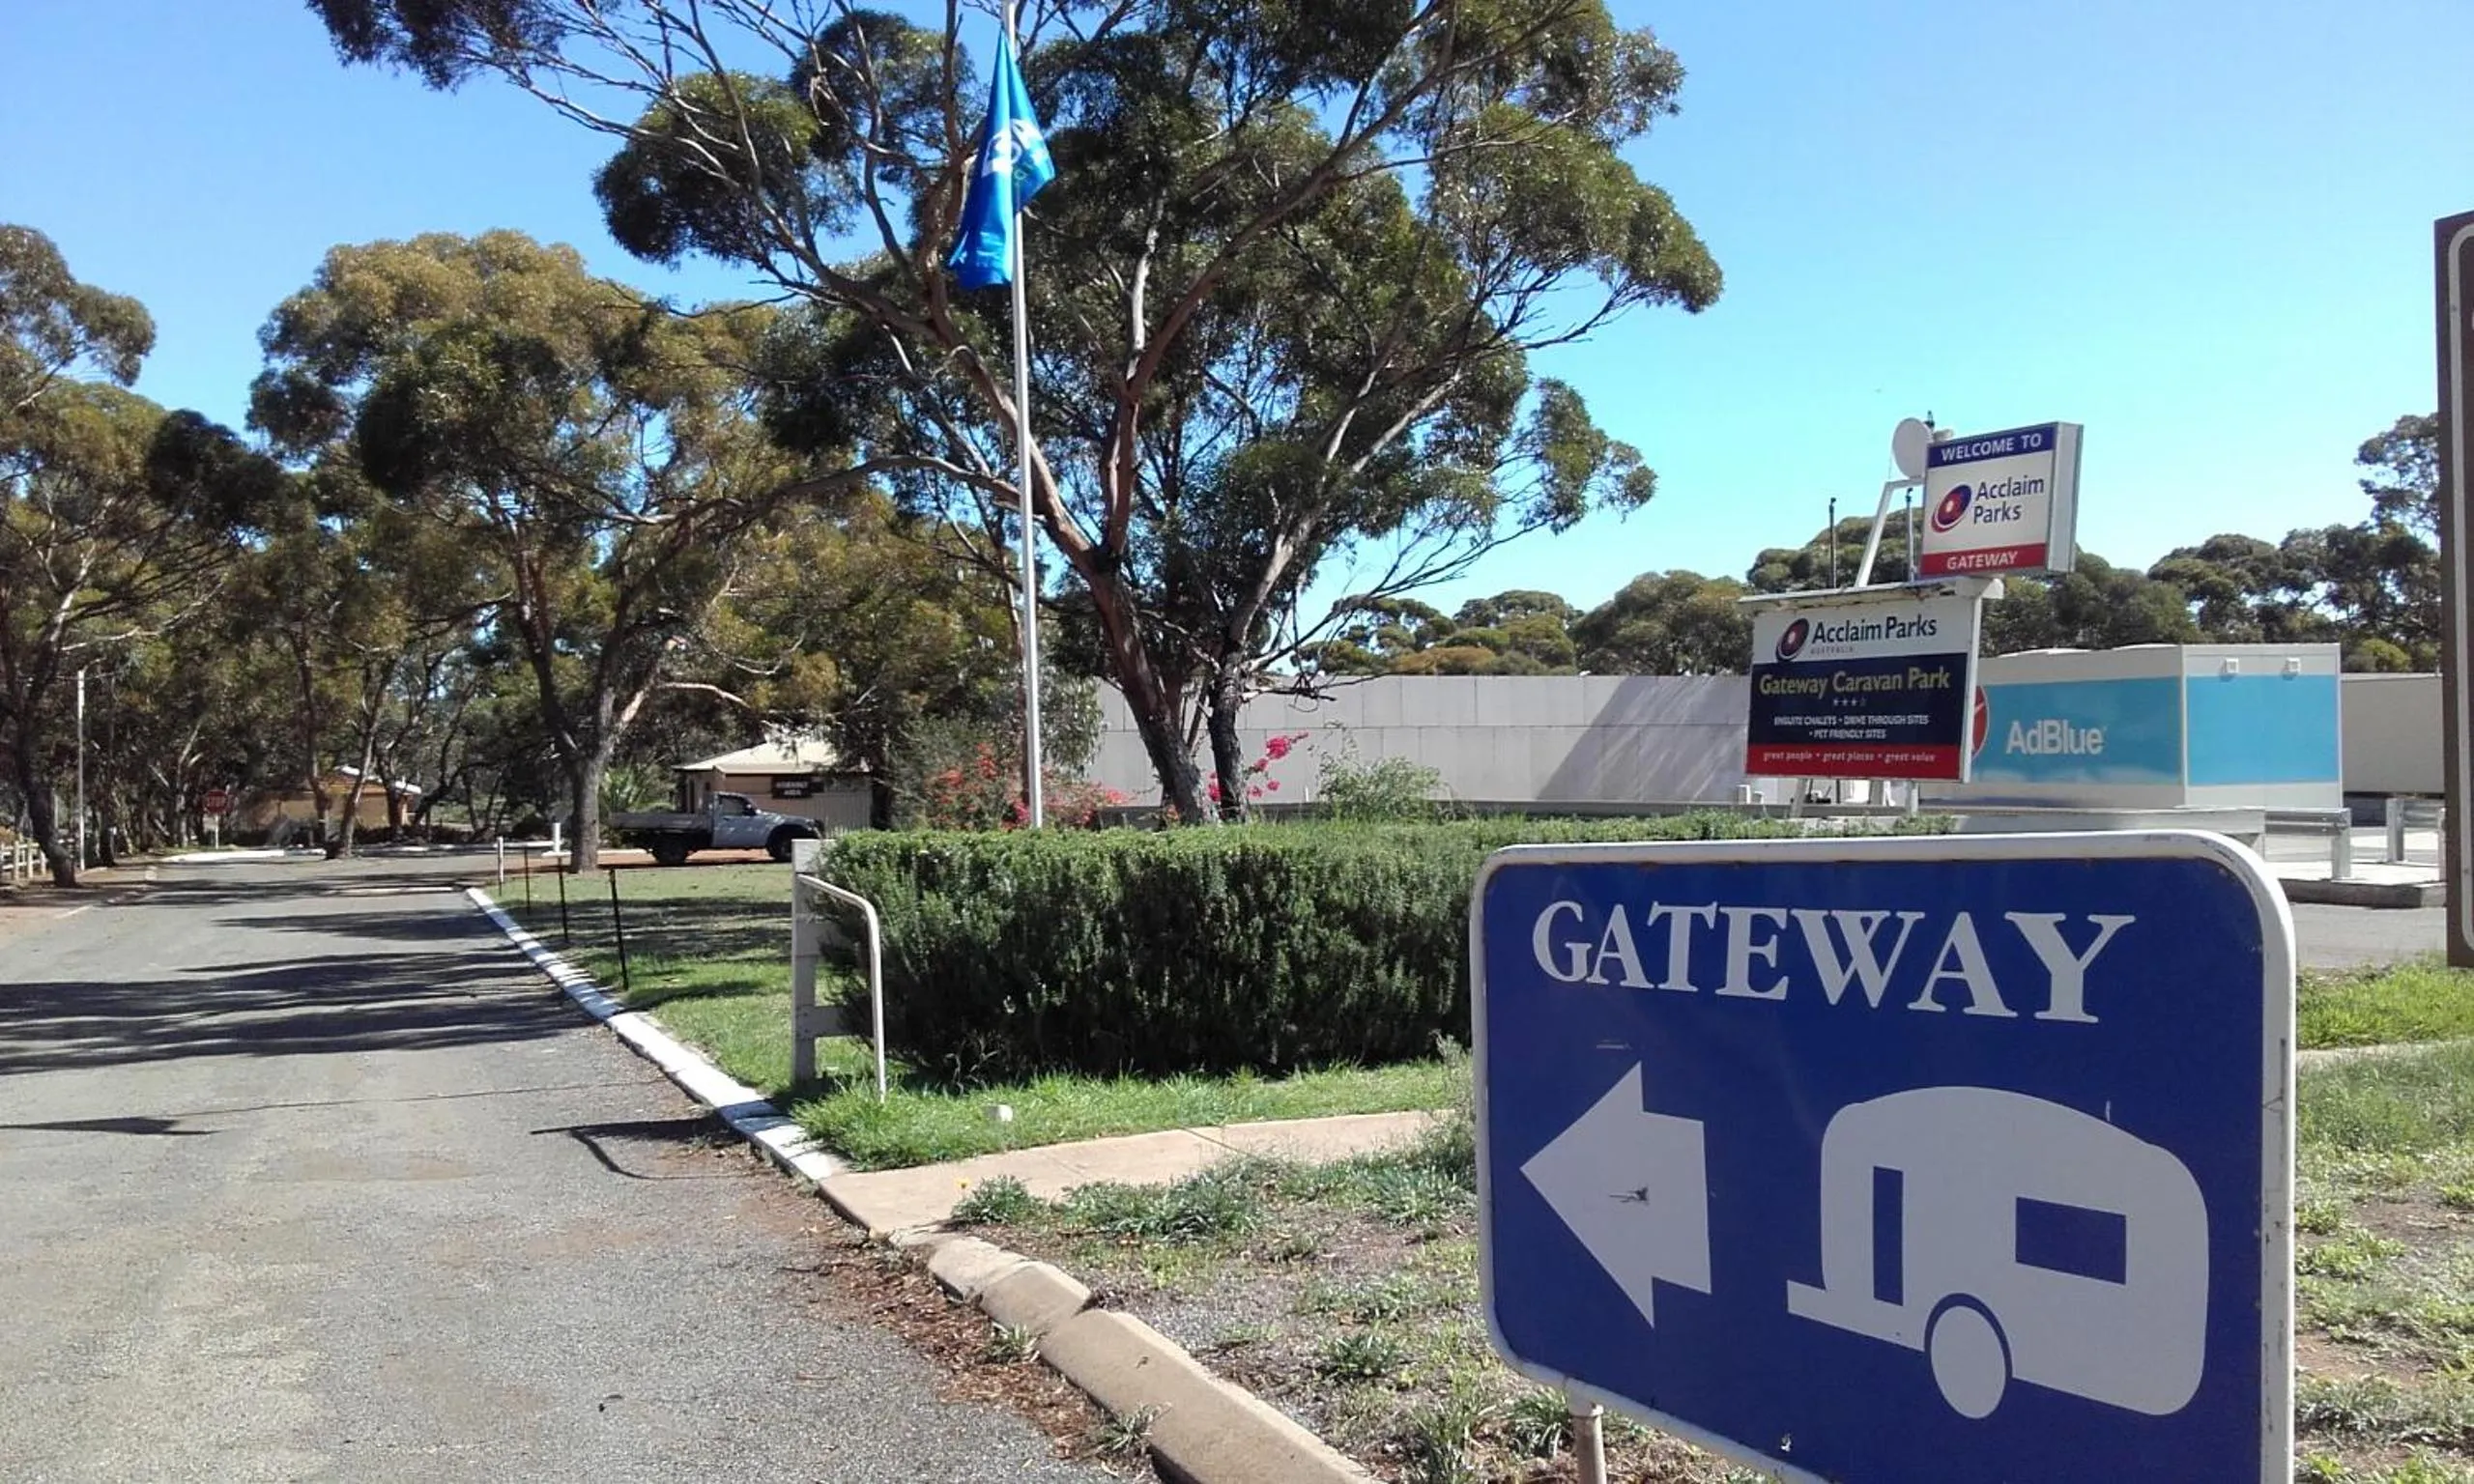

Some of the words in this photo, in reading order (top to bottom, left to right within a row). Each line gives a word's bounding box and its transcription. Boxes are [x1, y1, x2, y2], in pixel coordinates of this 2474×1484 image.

[1941, 438, 2014, 462] WELCOME
[2022, 433, 2041, 449] TO
[1975, 476, 2045, 501] Acclaim
[1972, 501, 2022, 525] Parks
[1946, 551, 2019, 571] GATEWAY
[1811, 618, 1883, 644] Acclaim
[1884, 614, 1938, 640] Parks
[1758, 673, 1829, 699] Gateway
[1831, 670, 1903, 693] Caravan
[1907, 665, 1951, 690] Park
[1867, 715, 1906, 725] THROUGH
[1907, 714, 1930, 725] SITES
[1813, 728, 1828, 739] PET
[1828, 728, 1863, 739] FRIENDLY
[1864, 728, 1886, 739] SITES
[2005, 718, 2104, 755] AdBlue
[1532, 899, 2136, 1024] GATEWAY
